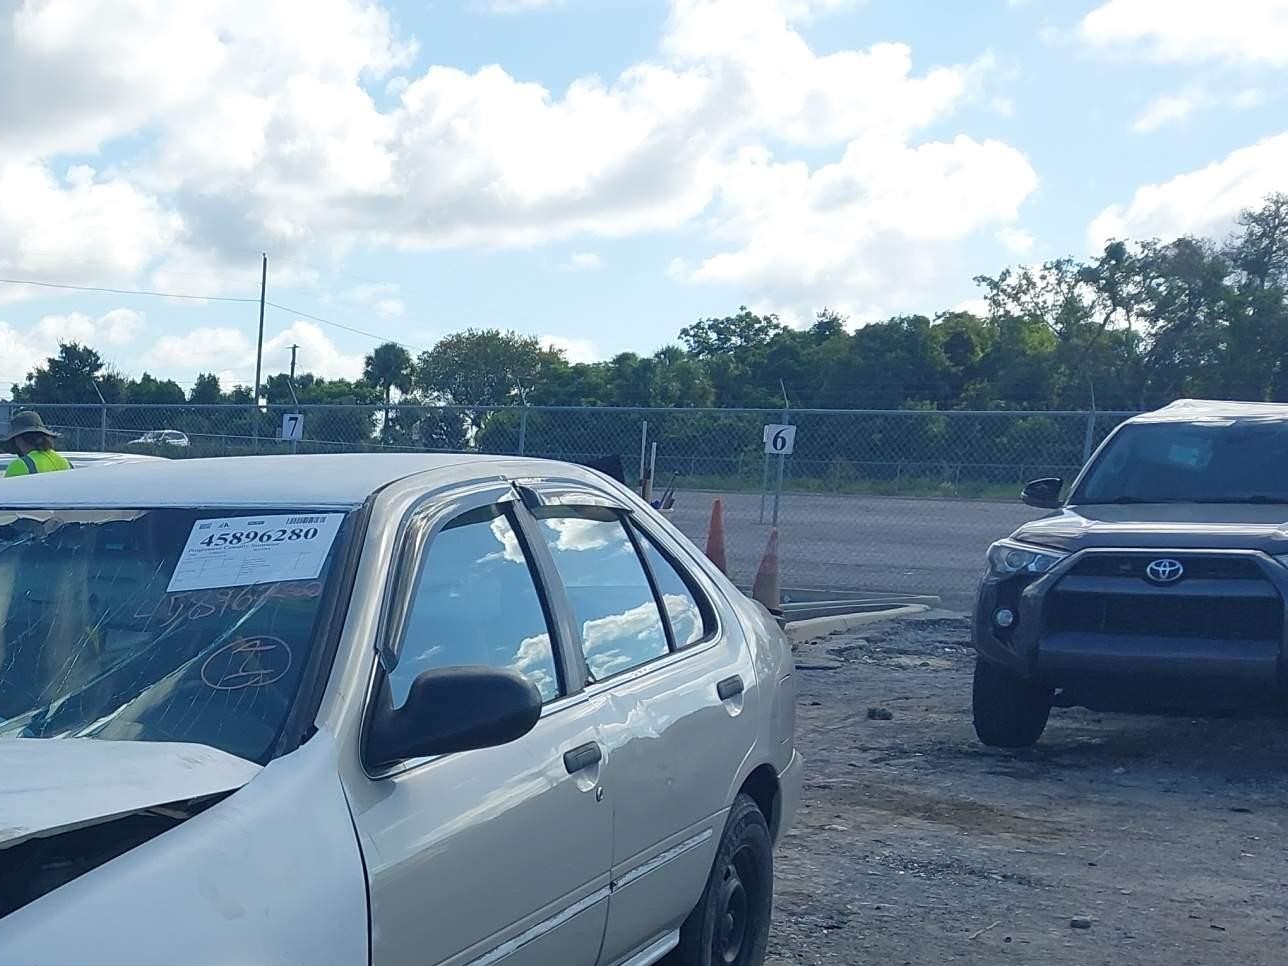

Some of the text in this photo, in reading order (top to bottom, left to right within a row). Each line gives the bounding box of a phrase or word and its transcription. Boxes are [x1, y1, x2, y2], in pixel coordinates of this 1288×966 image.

[288, 417, 299, 437] 7
[772, 428, 788, 451] 6
[199, 527, 318, 547] 45896280
